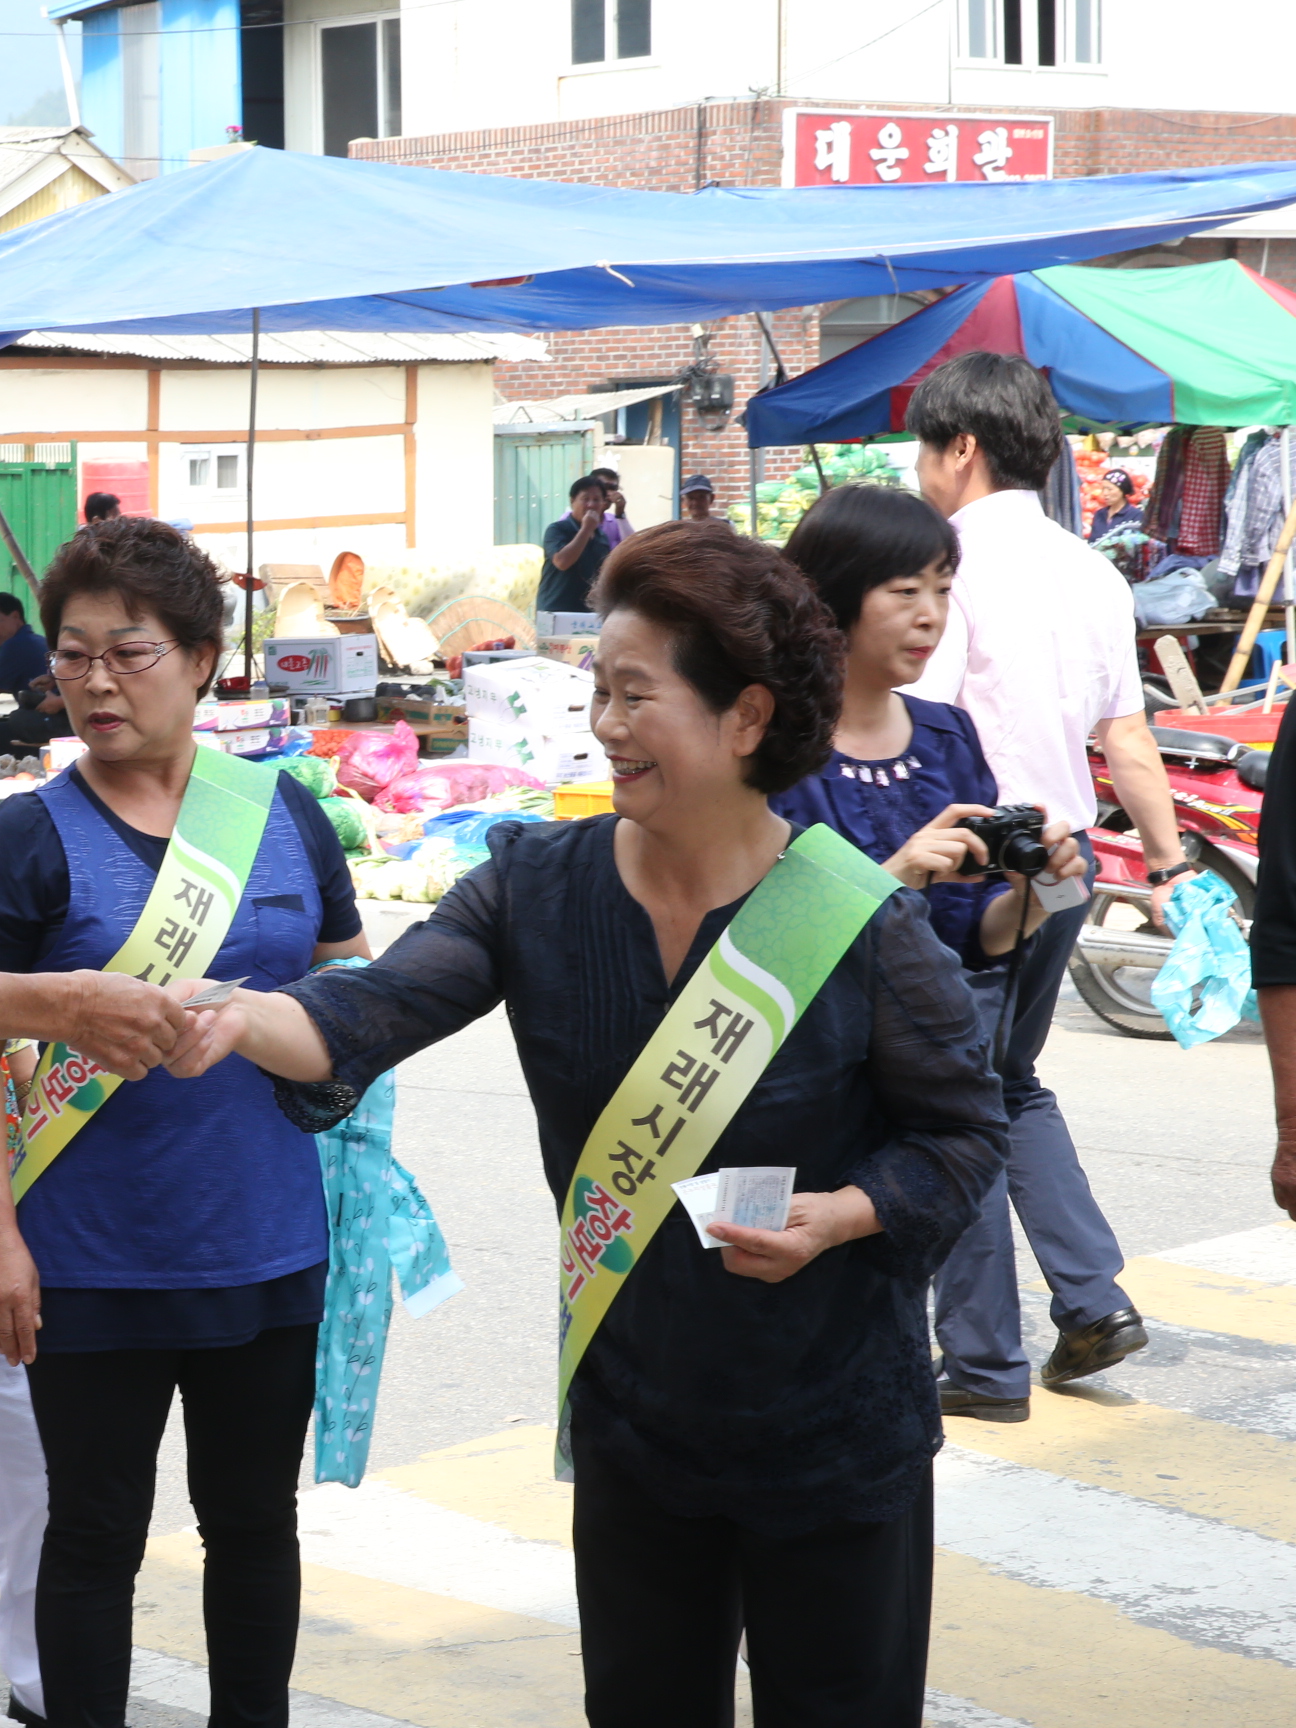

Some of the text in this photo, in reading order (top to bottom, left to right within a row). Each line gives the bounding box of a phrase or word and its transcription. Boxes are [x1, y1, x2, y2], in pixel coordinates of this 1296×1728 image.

[814, 121, 1013, 182] 대운회관
[608, 998, 755, 1196] 재래시장
[560, 1183, 633, 1301] 장보기
